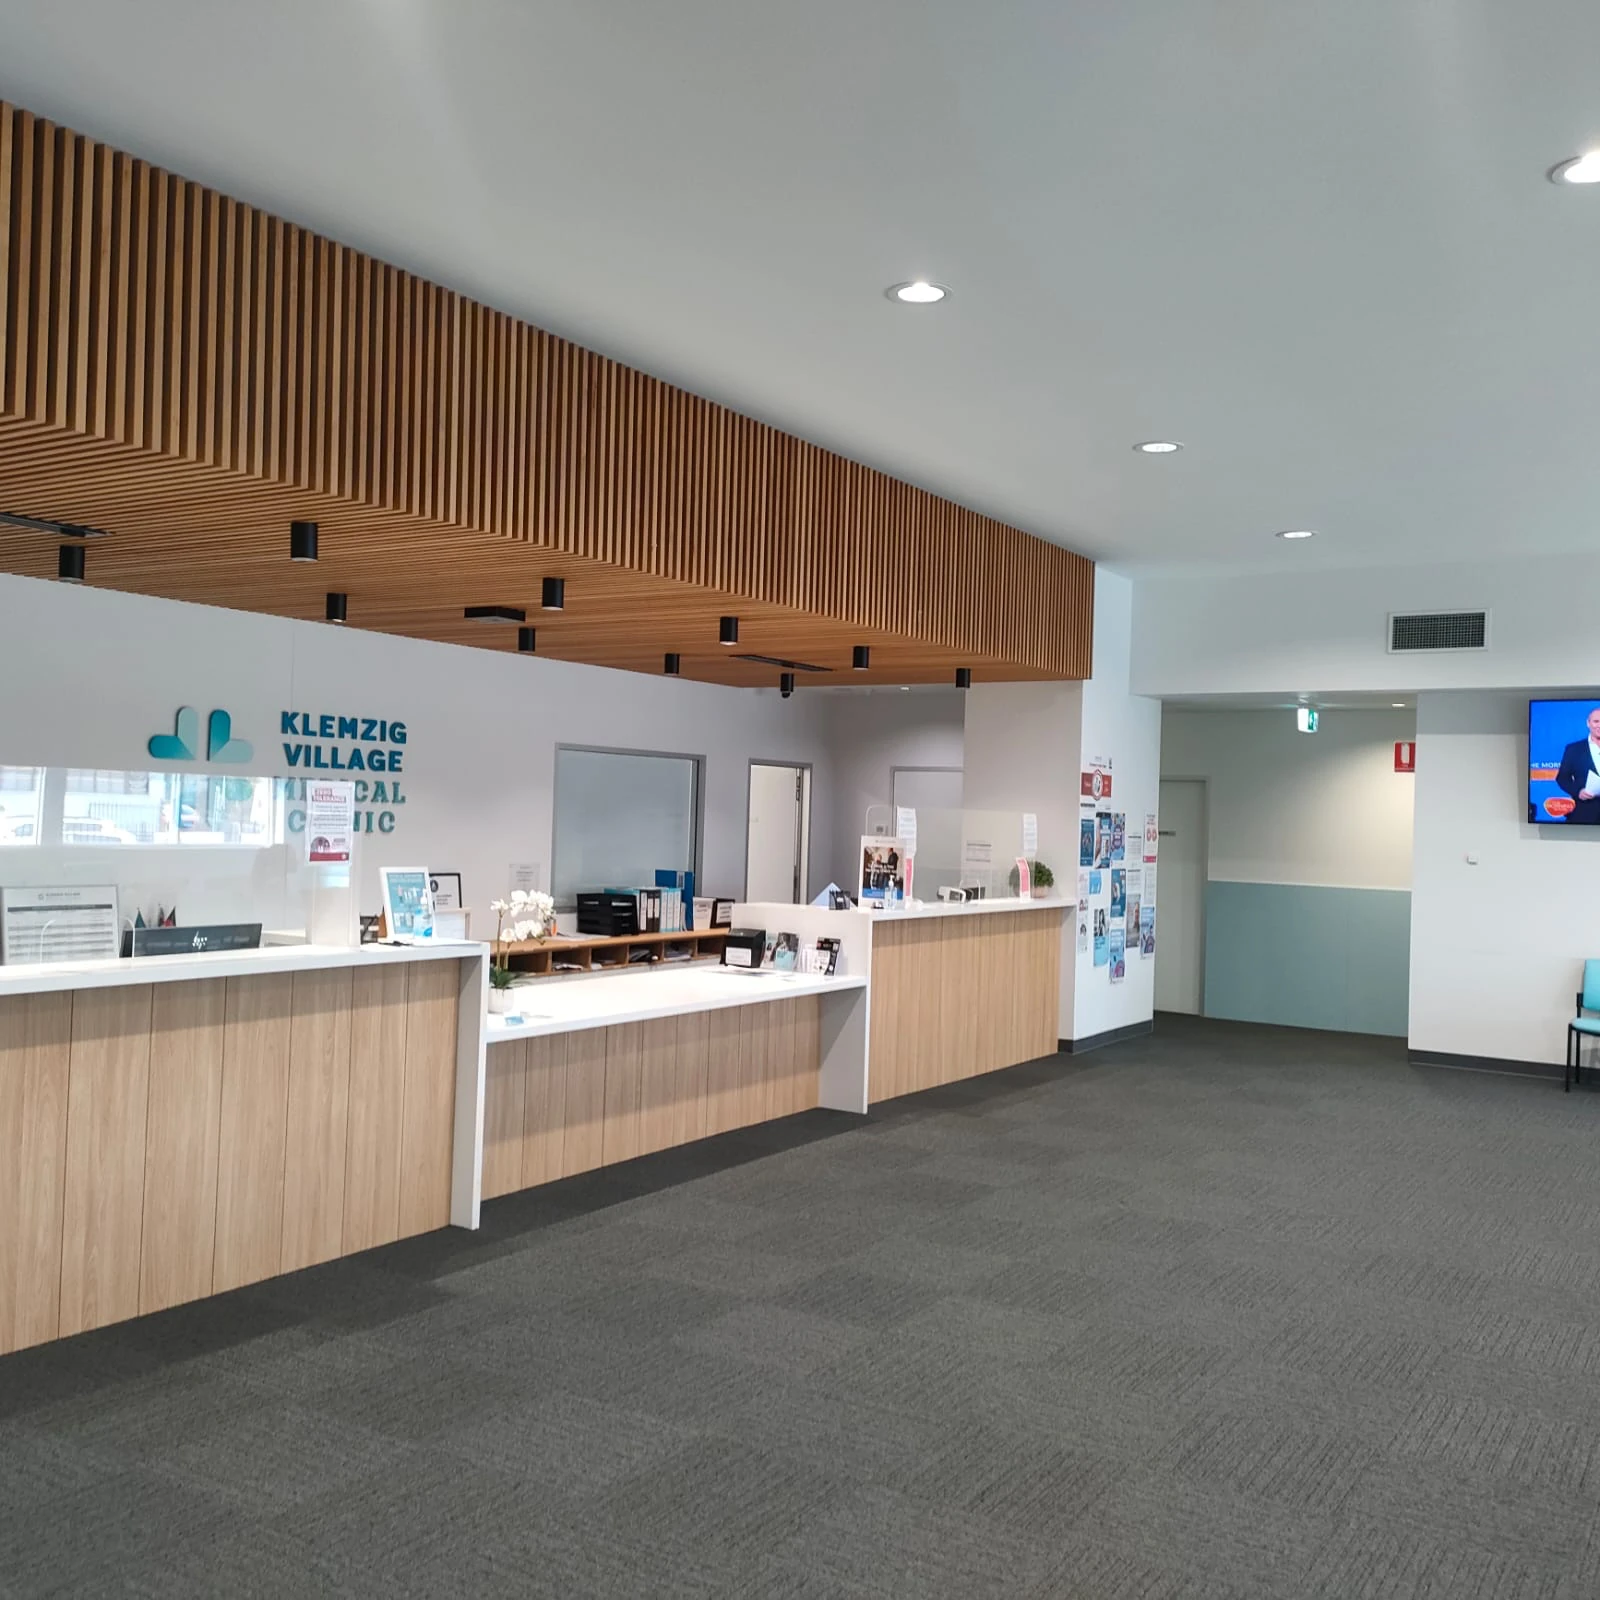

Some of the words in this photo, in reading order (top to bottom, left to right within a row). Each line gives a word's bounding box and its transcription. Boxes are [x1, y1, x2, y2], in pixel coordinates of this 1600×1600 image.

[281, 711, 407, 744] KLEMZIG
[283, 743, 403, 772] VILLAGE
[273, 776, 406, 804] MCAL
[287, 809, 396, 833] CIC
